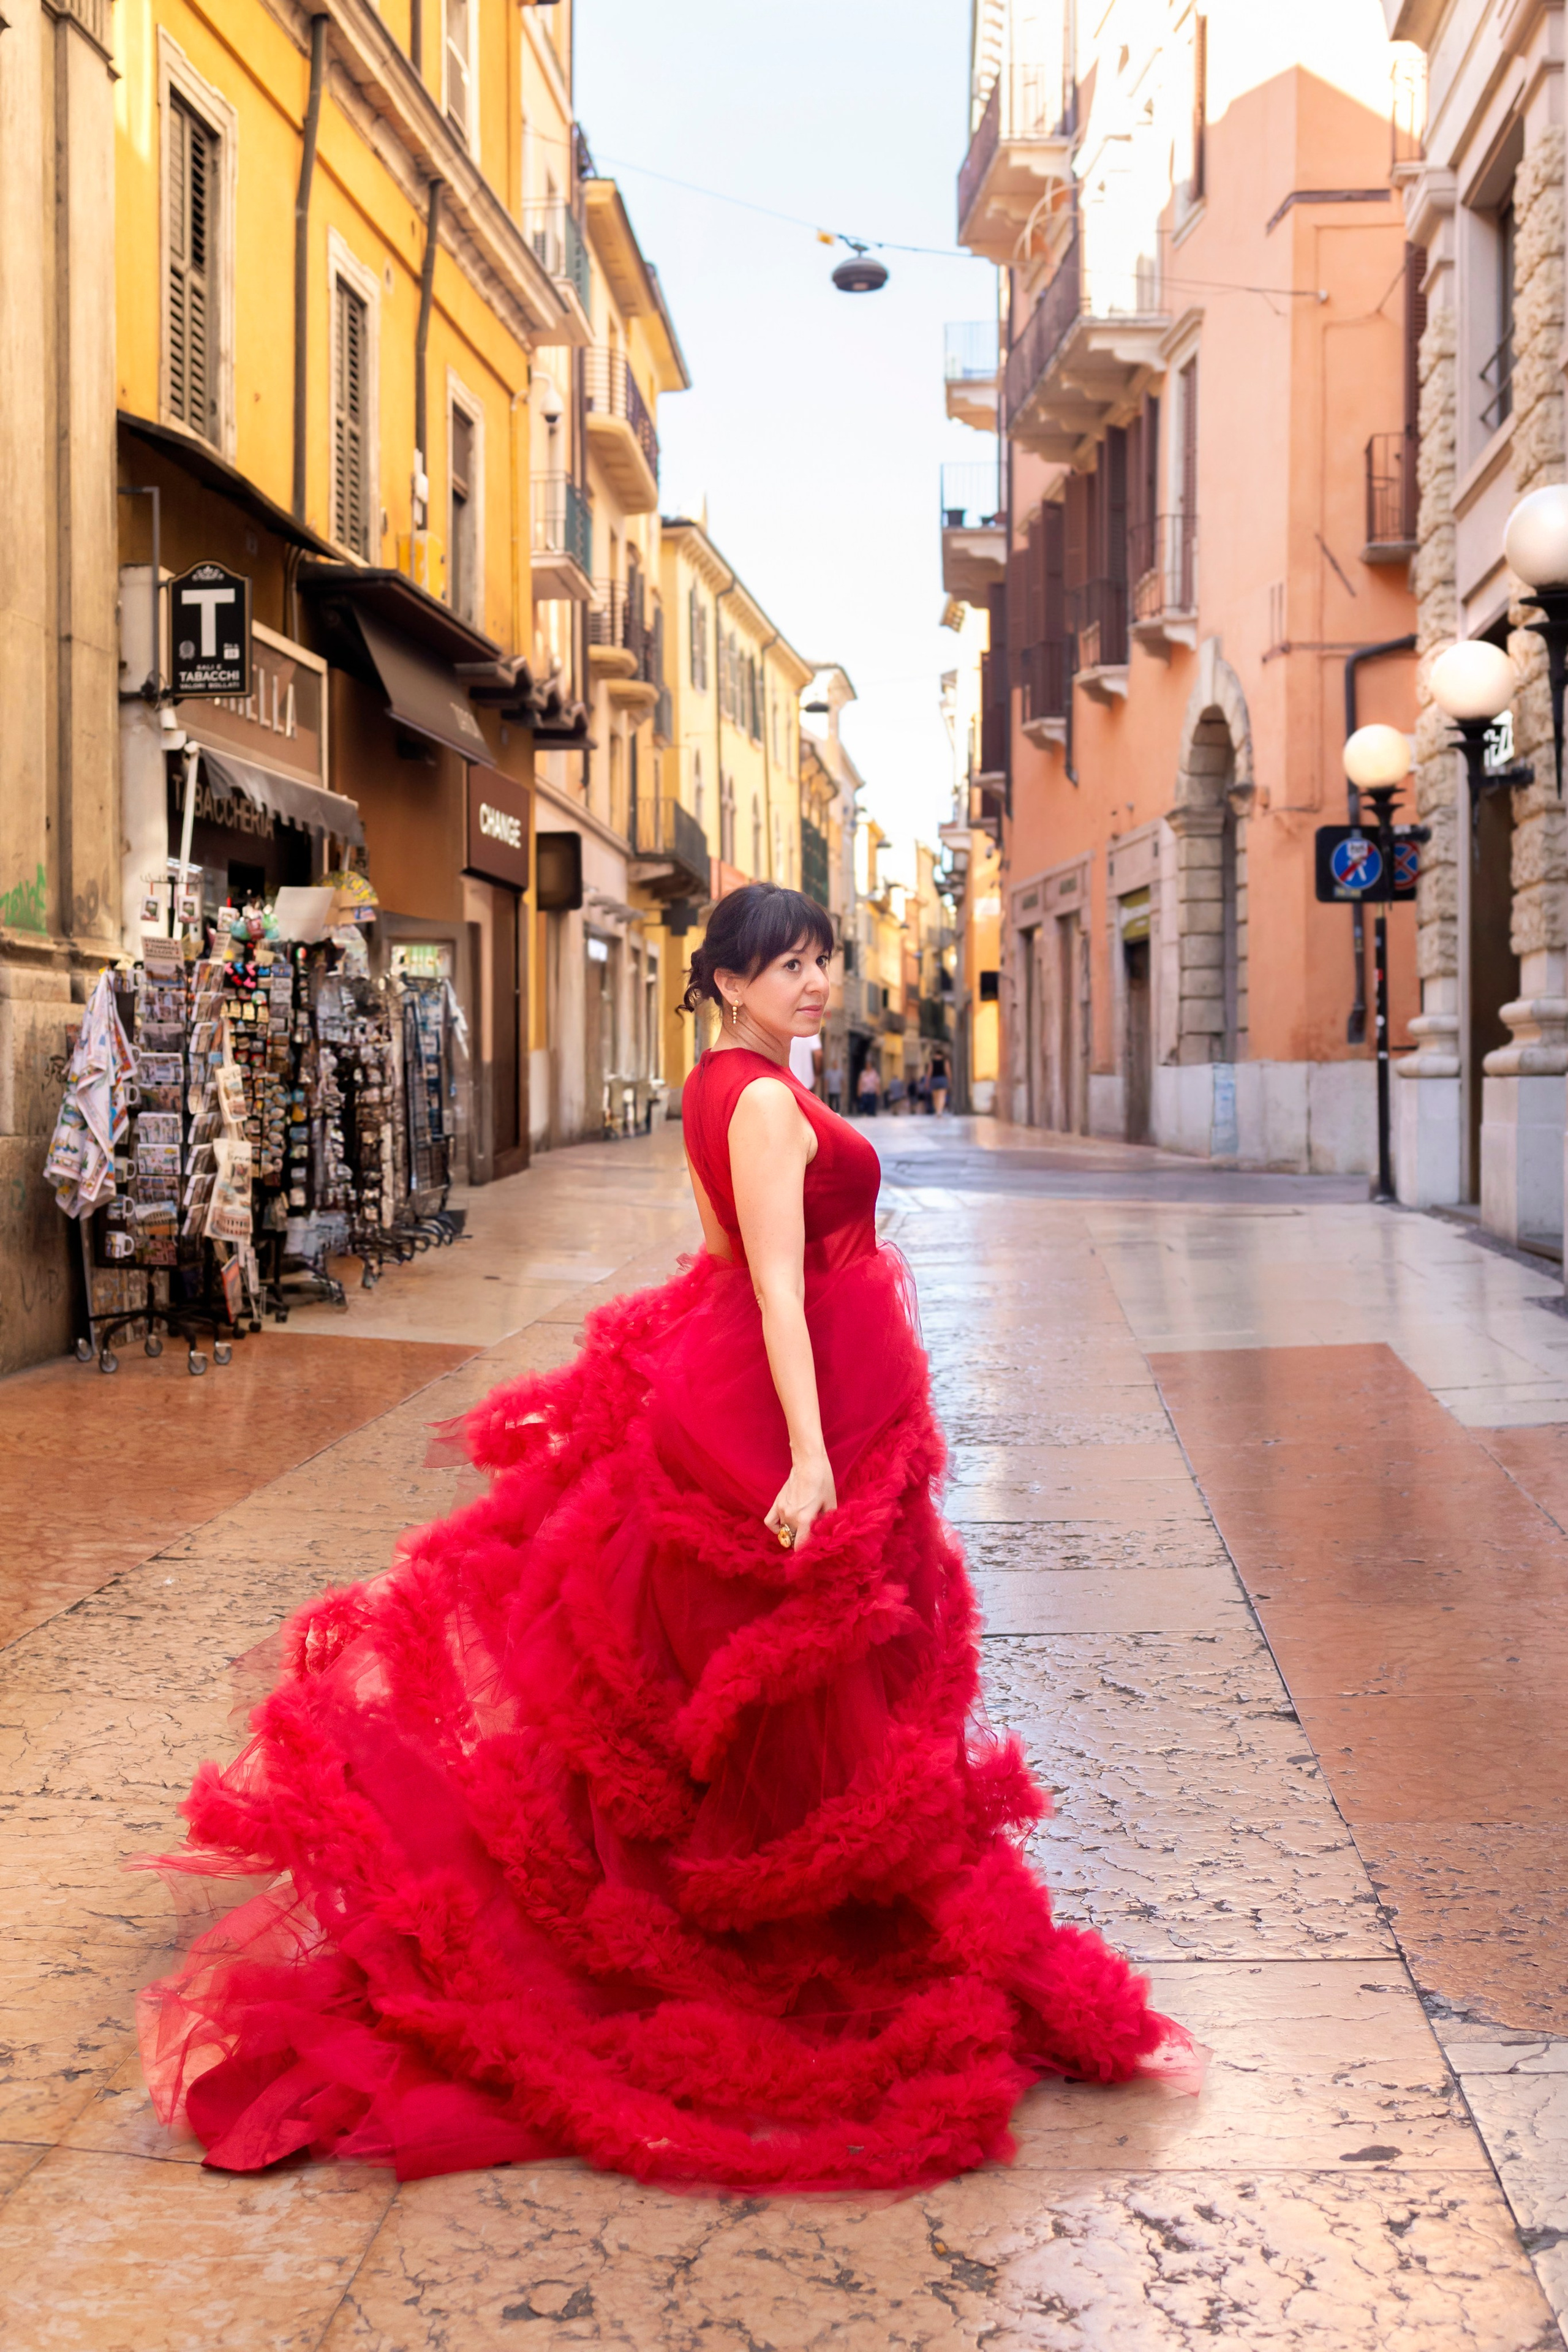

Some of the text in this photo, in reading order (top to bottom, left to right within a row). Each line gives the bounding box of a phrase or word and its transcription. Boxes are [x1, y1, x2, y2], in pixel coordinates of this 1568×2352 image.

[181, 588, 235, 657] T
[179, 670, 239, 682] TABACCHI
[172, 773, 275, 840] TBACCHERIA
[479, 802, 521, 849] CHANGE
